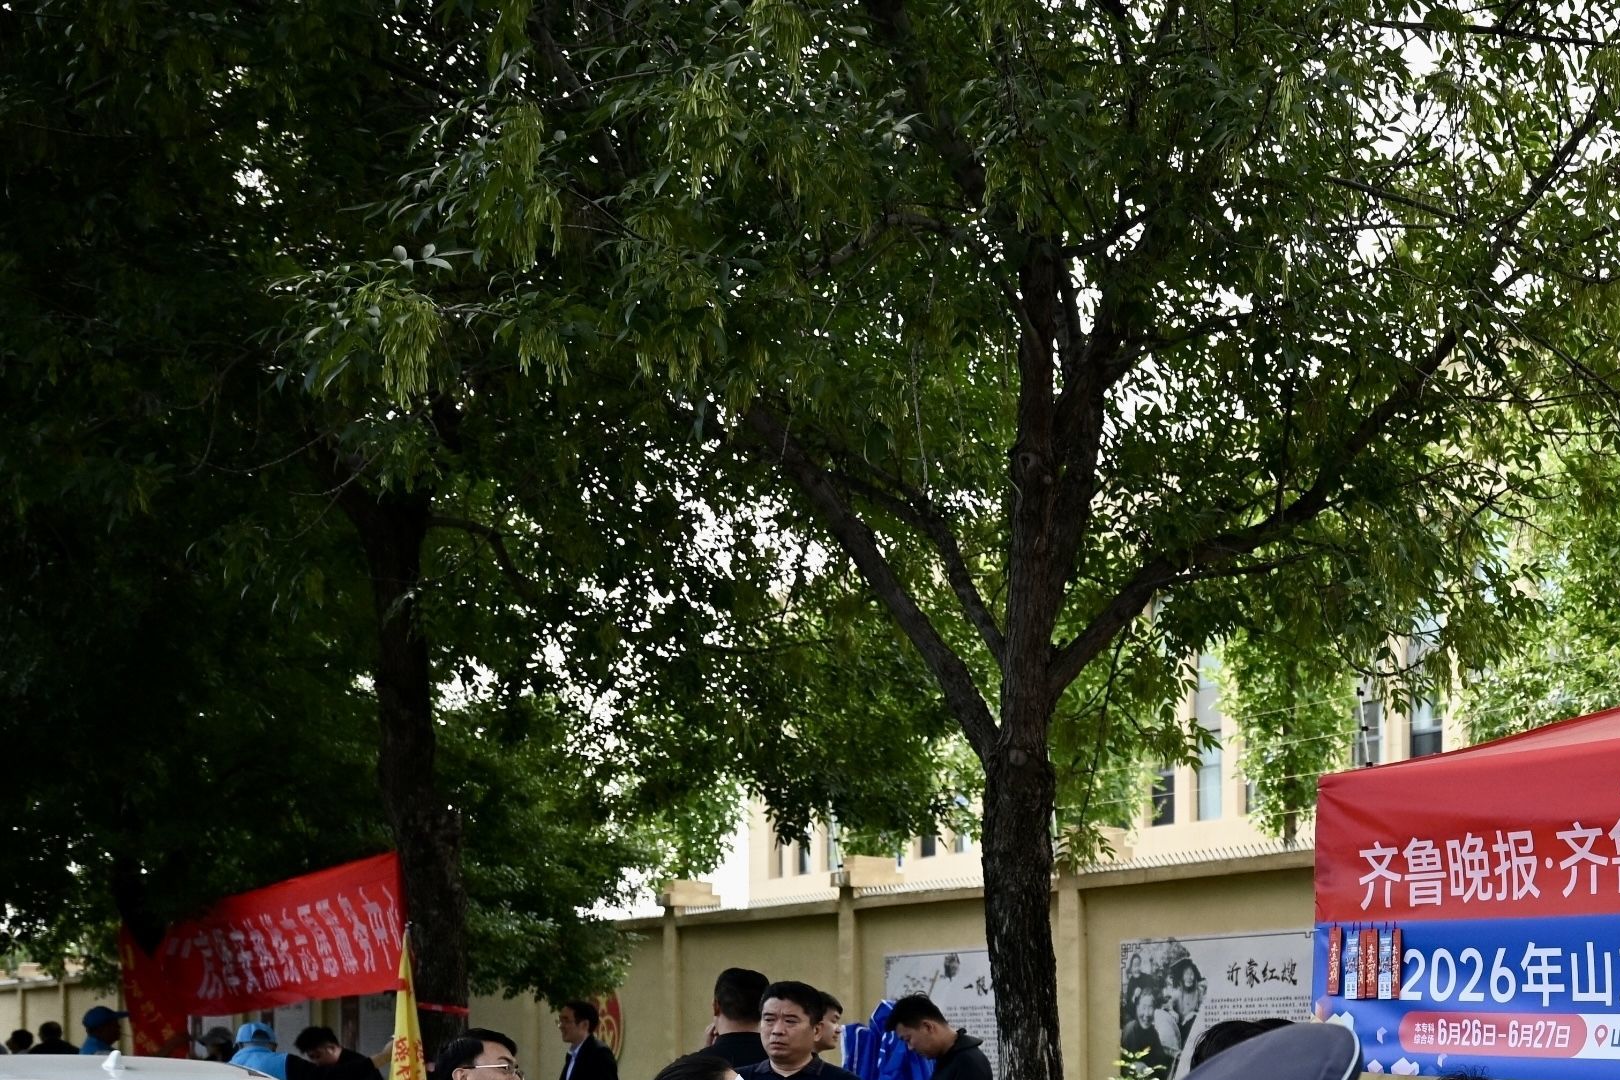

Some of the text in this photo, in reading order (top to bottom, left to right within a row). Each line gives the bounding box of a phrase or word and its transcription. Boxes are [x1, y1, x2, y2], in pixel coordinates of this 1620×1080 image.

[963, 975, 994, 996] 一根
[1414, 1022, 1435, 1034] 本专科
[1414, 1034, 1434, 1045] 综合场
